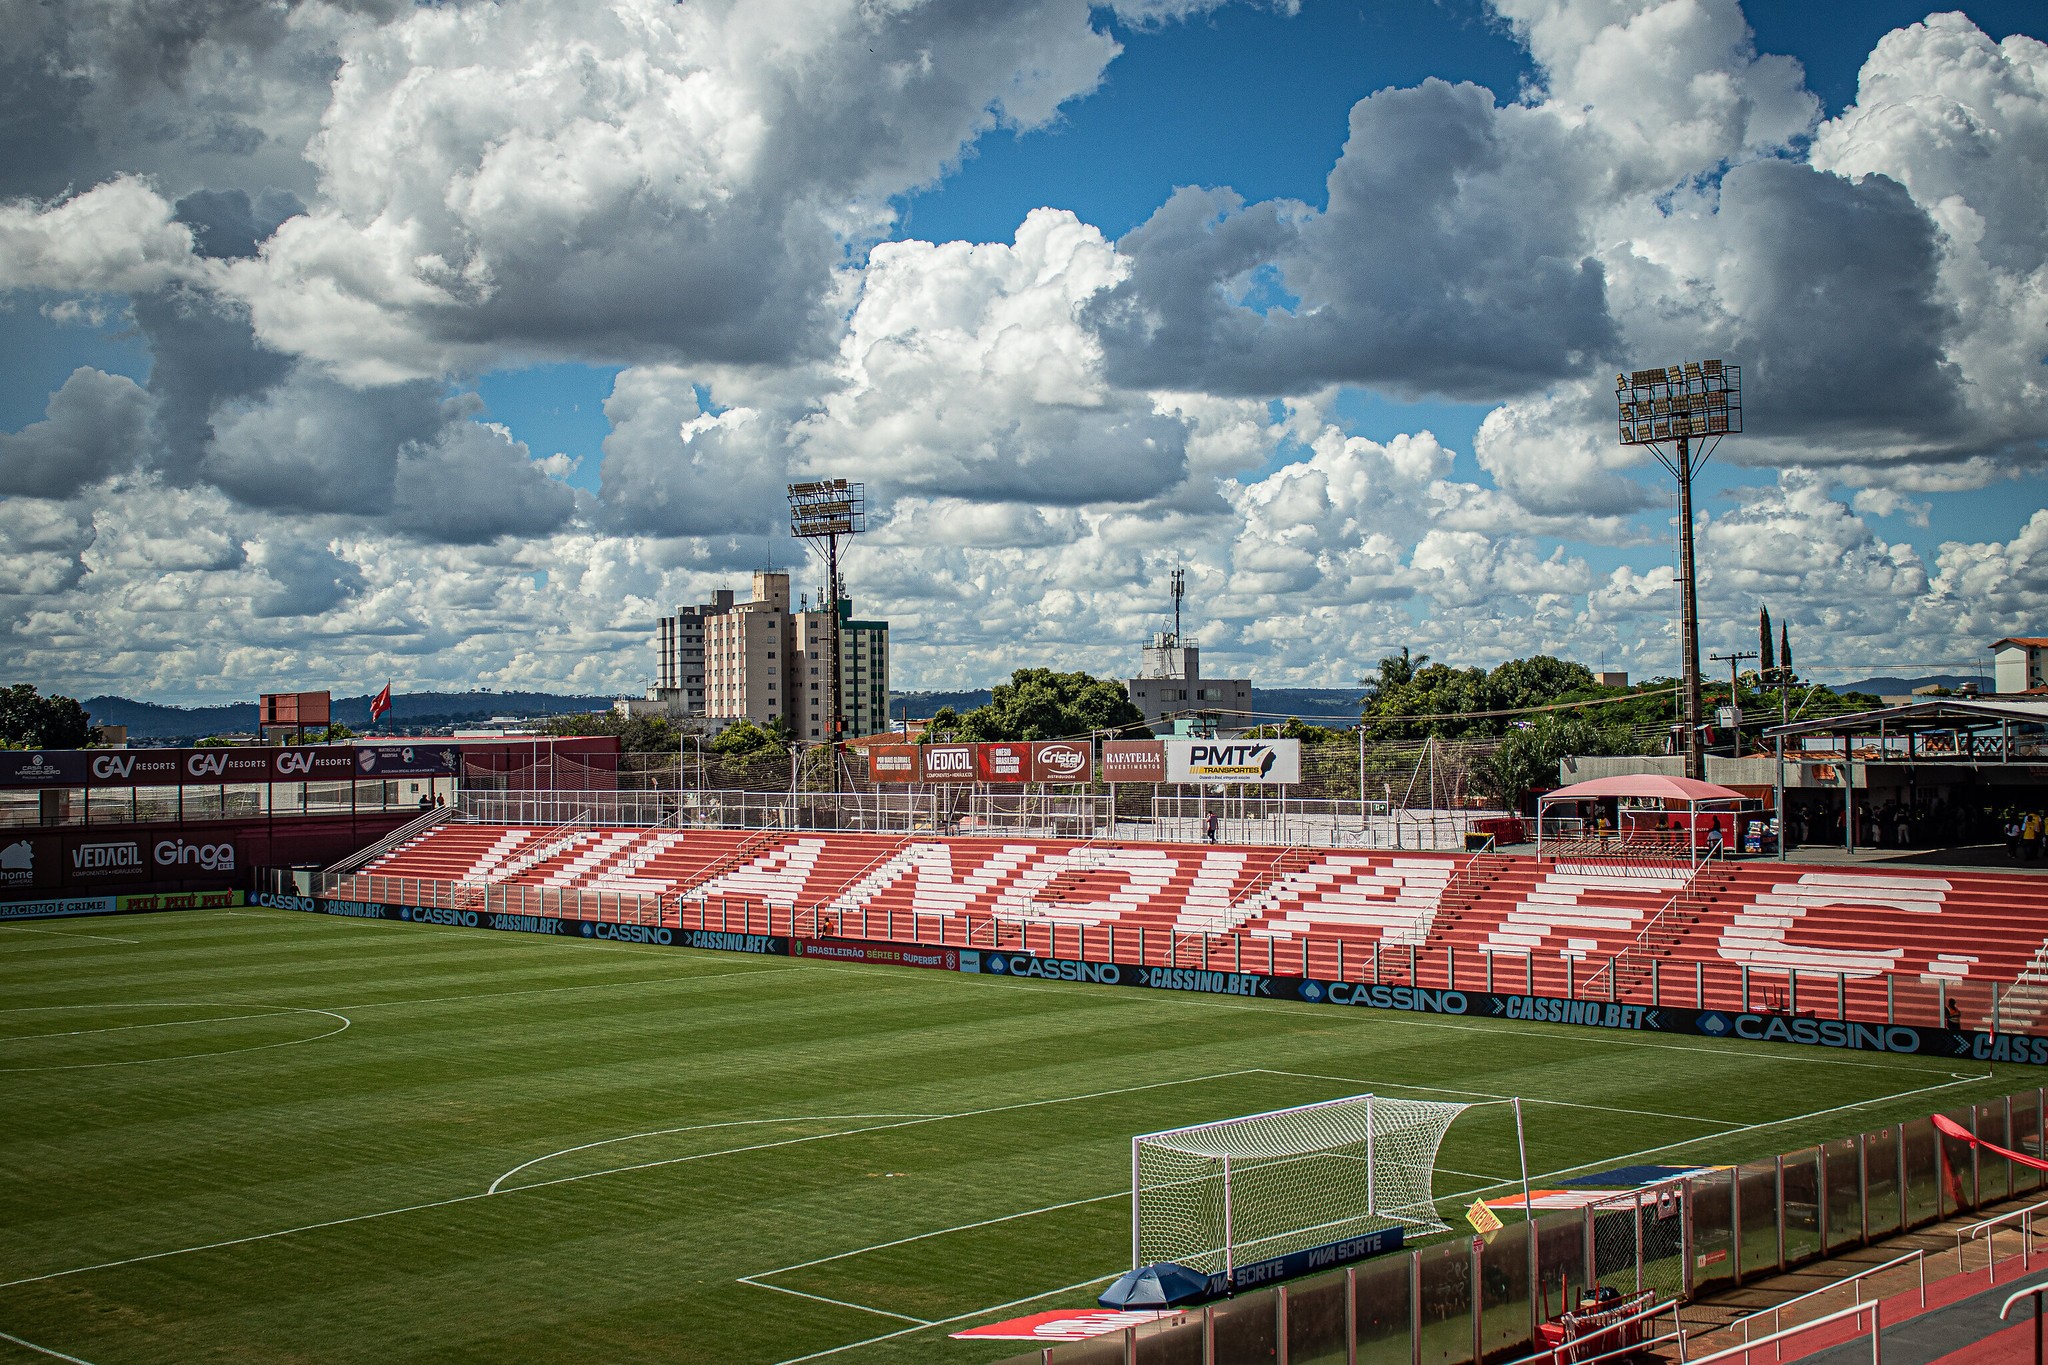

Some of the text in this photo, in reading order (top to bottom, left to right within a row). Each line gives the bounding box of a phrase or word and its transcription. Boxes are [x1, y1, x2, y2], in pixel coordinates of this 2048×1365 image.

[92, 755, 176, 778] GAV RESORTS
[188, 754, 266, 777] GAV RESORTS
[276, 752, 351, 774] GAV RESORTS
[926, 748, 973, 770] VEDACIL
[1042, 750, 1082, 764] Cristal
[1106, 752, 1160, 763] RAFATELLA
[1190, 746, 1250, 766] PMT
[72, 842, 143, 868] VEDACIL
[154, 838, 234, 870] Ginga
[1, 870, 33, 880] home
[2, 900, 106, 916] RACISMO É CRIME!
[260, 892, 380, 918] CASSINO CASSINO.BET
[412, 907, 558, 934] CASSINO CASSINO.BET
[596, 923, 768, 953] CASSINO CASSINO.BET
[807, 946, 942, 965] BRASILEIRÃO SÉRIE B SUPERBET
[1010, 956, 1260, 996] CASSINO CASSINO.BET
[1328, 982, 1646, 1030] CASSINO CASSINO.BET
[1735, 1014, 1920, 1052] CASSINO
[1308, 1234, 1381, 1267] VIVA SORTE
[1236, 1260, 1283, 1285] SORTE
